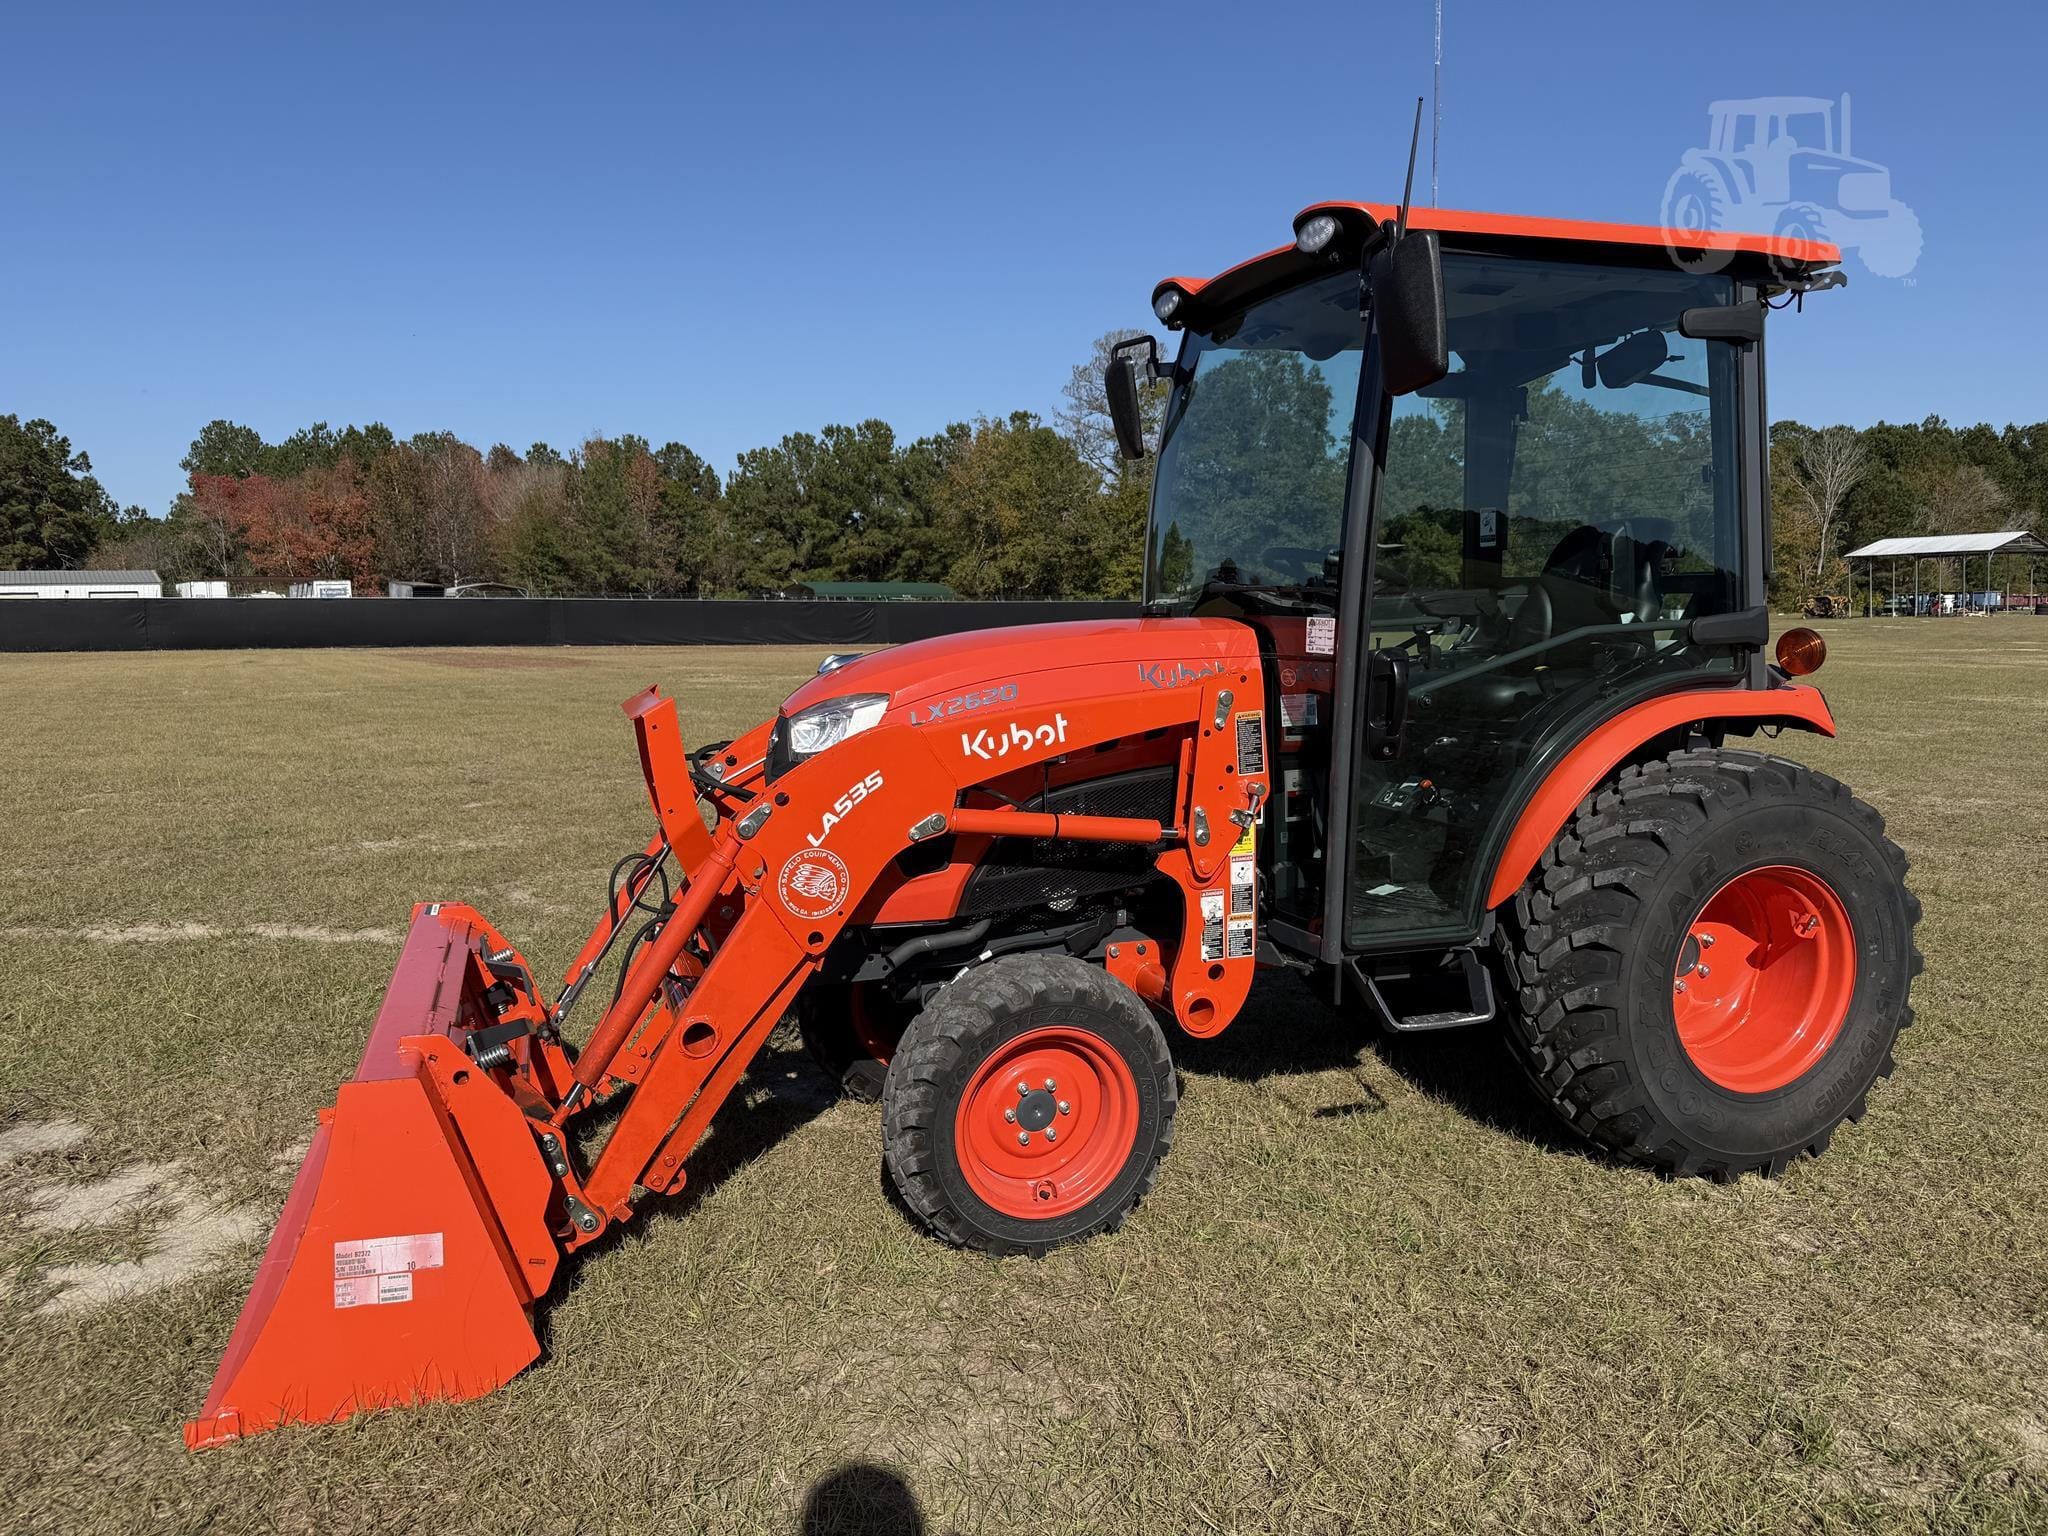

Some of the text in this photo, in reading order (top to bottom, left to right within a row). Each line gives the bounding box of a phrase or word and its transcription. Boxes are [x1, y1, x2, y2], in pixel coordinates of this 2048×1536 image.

[910, 682, 1018, 727] LX2620
[806, 769, 884, 847] LA535
[781, 856, 801, 884] SAPELO
